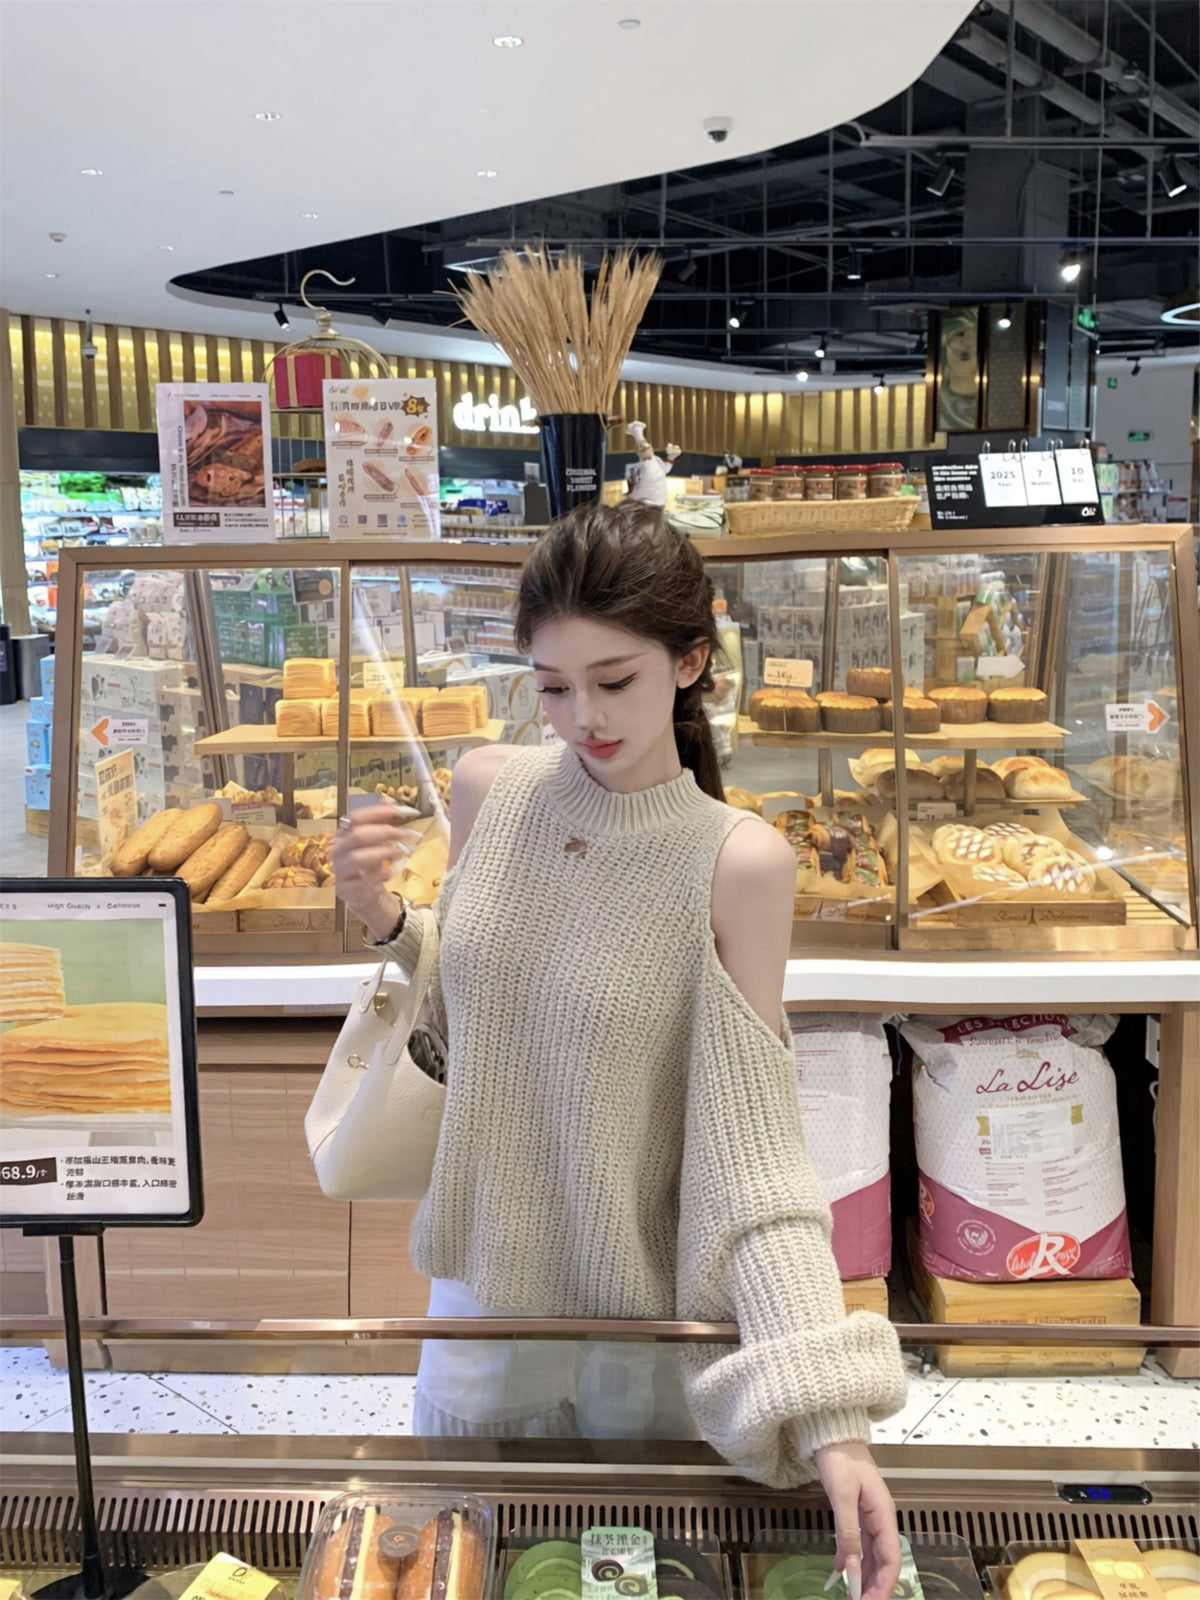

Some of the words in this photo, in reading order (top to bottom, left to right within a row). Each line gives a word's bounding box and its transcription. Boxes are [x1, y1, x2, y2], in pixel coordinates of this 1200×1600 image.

[990, 471, 1016, 479] 2025
[1036, 469, 1043, 478] 7
[1071, 467, 1084, 476] 10
[957, 1019, 983, 1034] LES
[976, 1068, 1013, 1094] La
[1017, 1061, 1080, 1093] Lise
